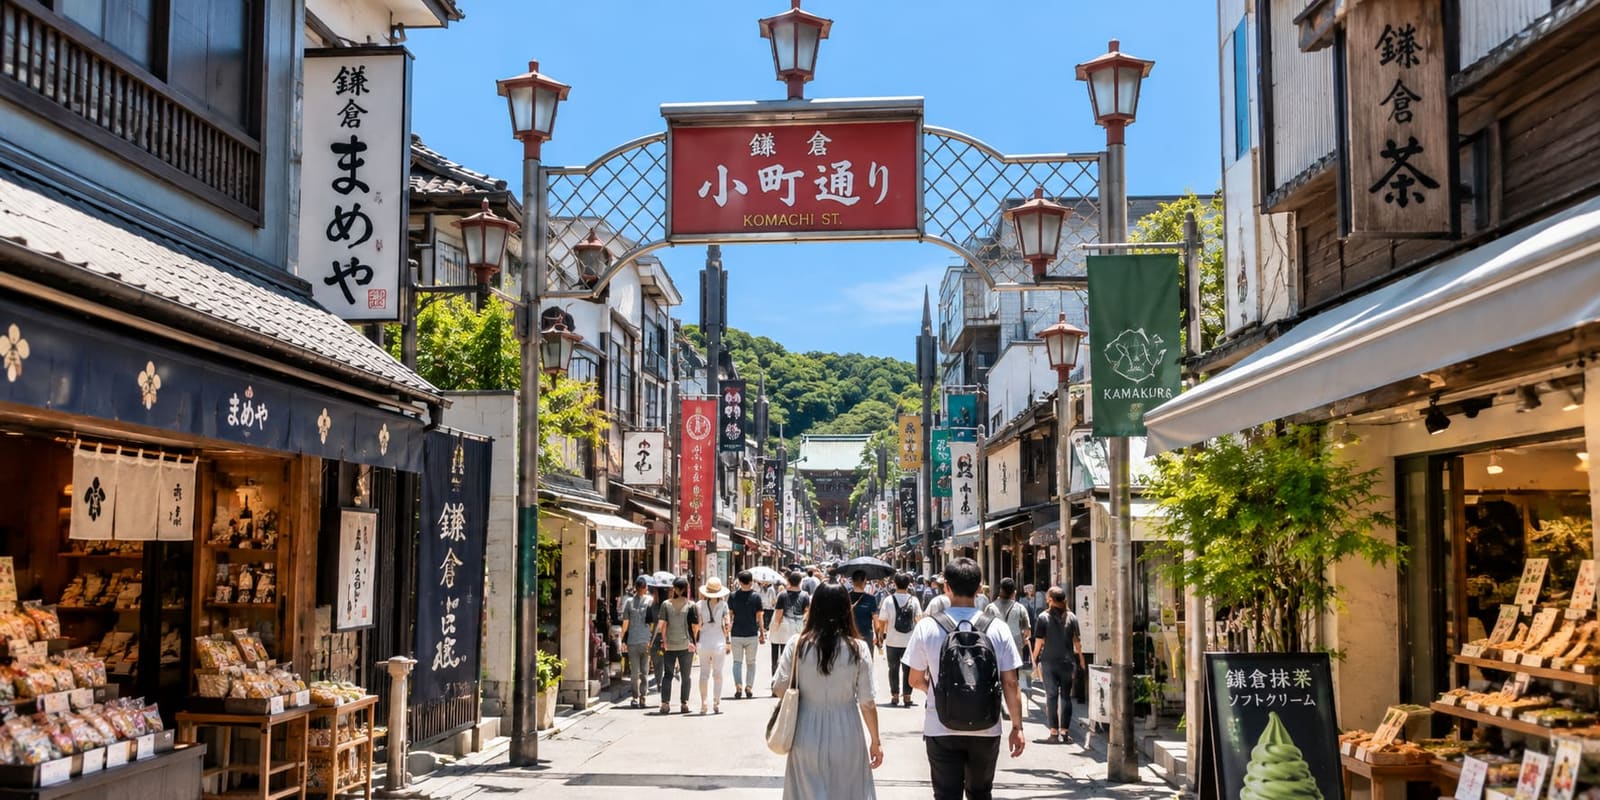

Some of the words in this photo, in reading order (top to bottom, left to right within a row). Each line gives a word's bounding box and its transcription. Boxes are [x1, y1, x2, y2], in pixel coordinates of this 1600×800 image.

[1368, 23, 1441, 208] 鎌倉茶
[698, 160, 889, 208] 小町通り
[743, 213, 814, 227] KOMACHI
[821, 212, 843, 226] ST.
[227, 392, 268, 431] まめや
[1228, 693, 1316, 707] ソフトクリーム
